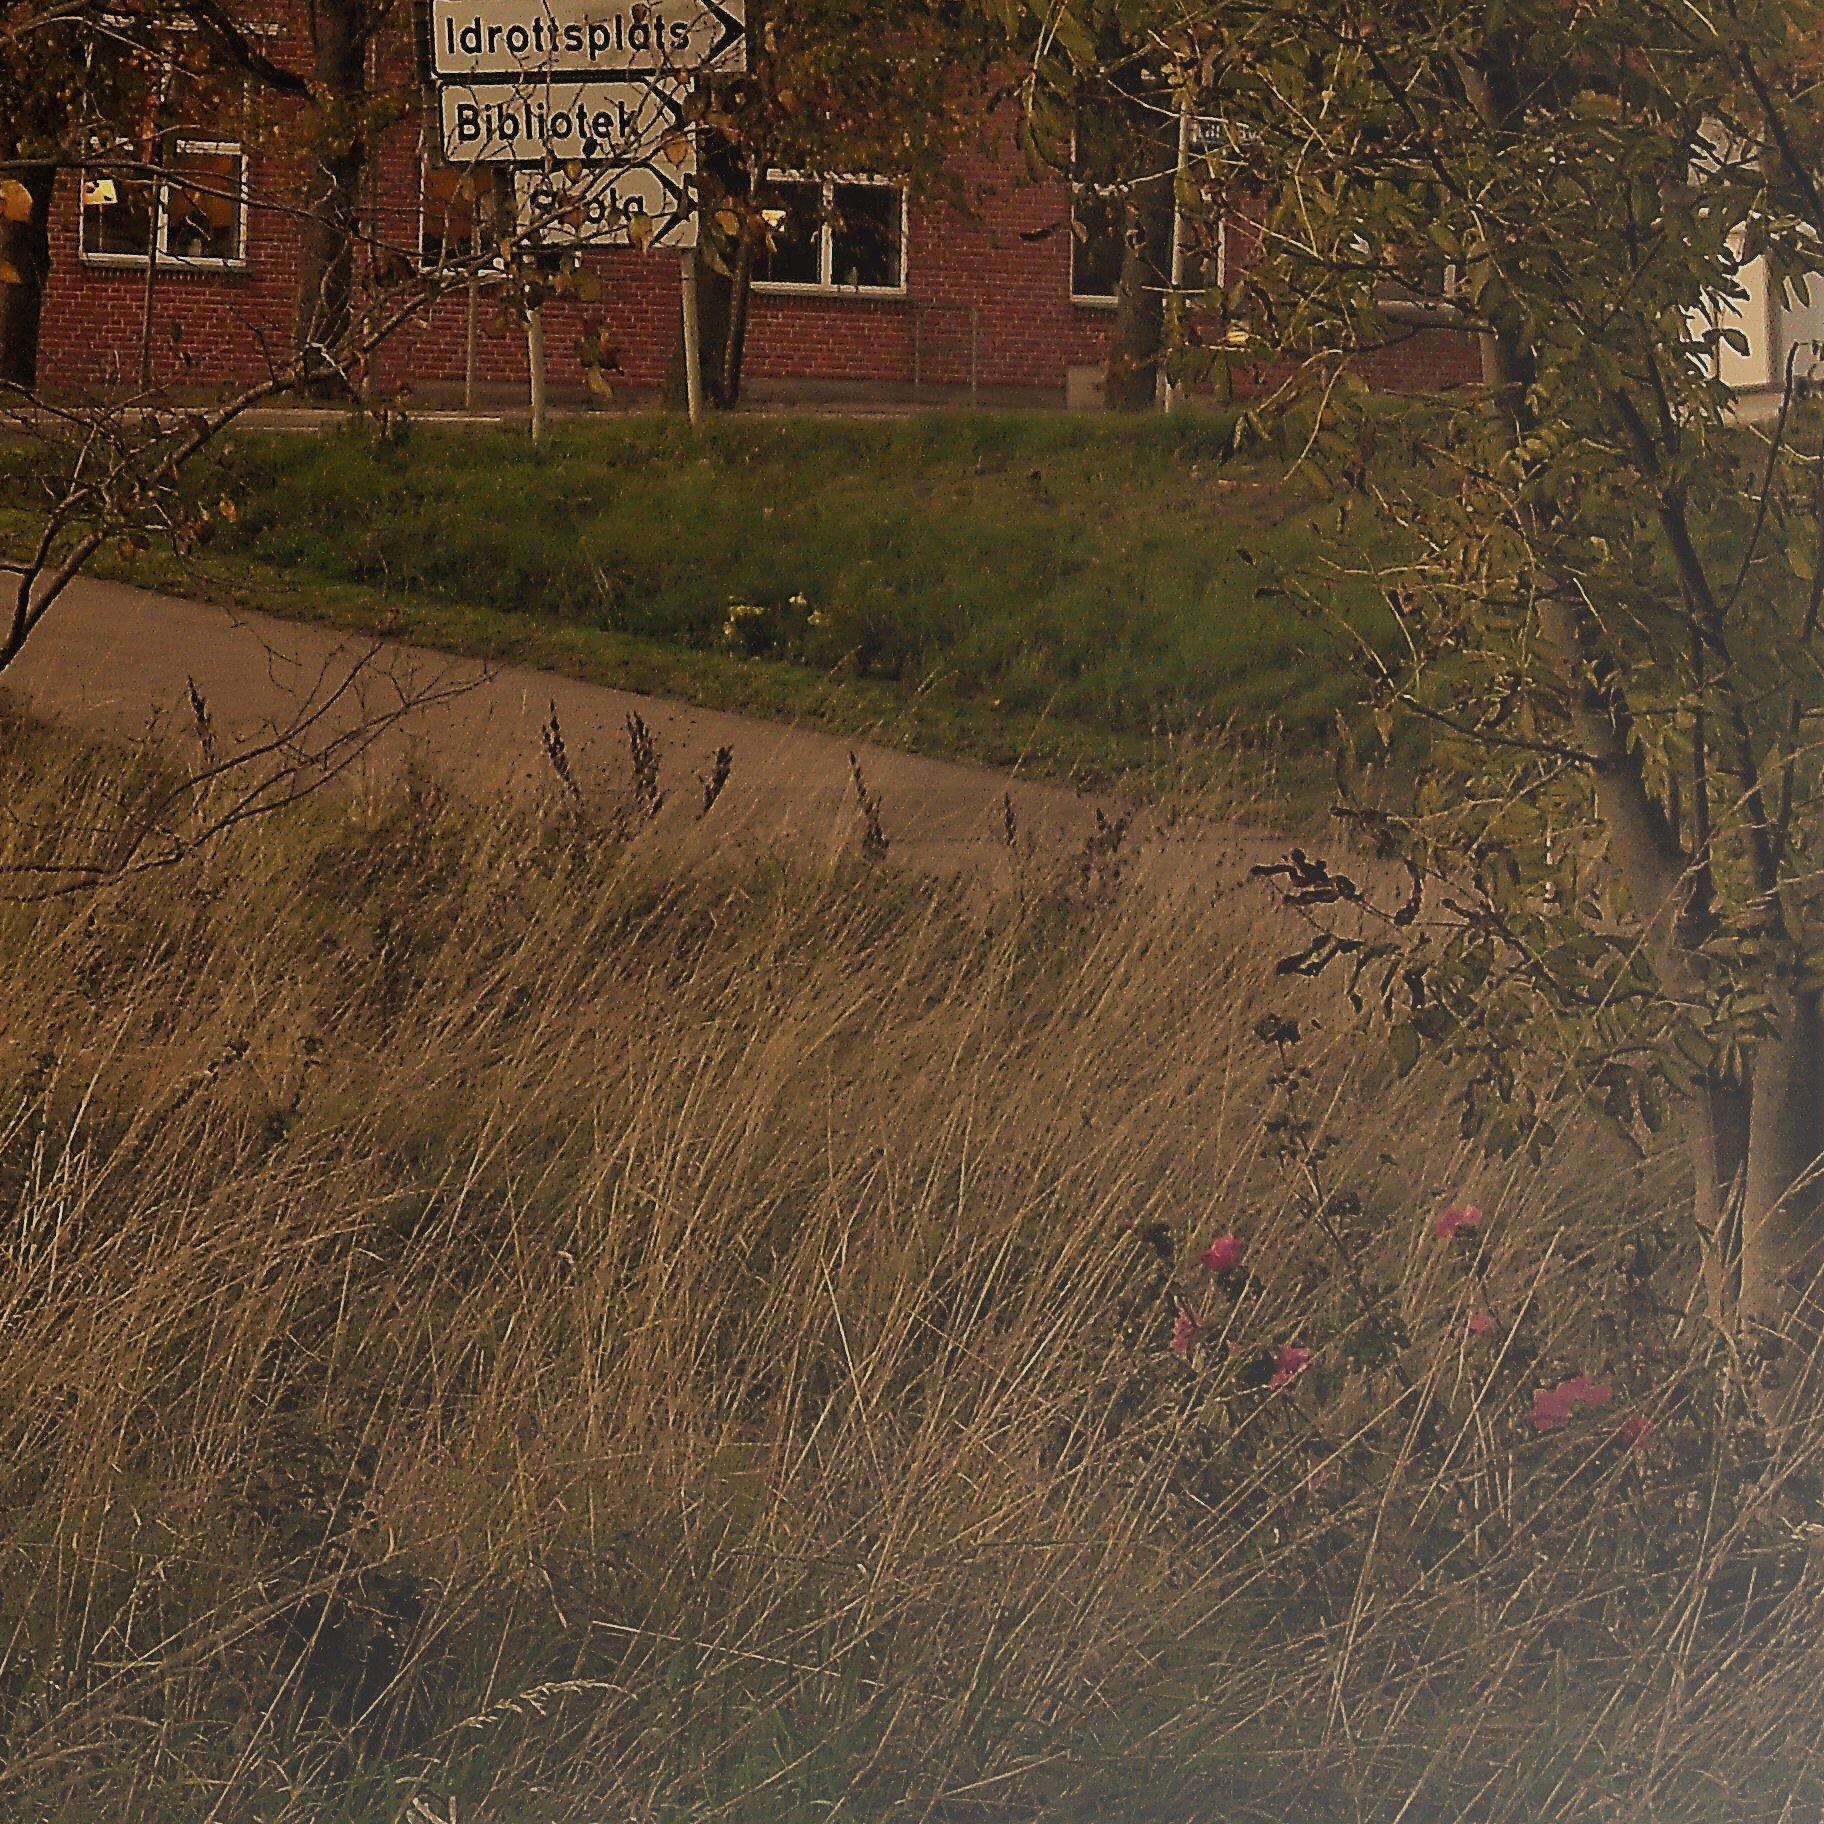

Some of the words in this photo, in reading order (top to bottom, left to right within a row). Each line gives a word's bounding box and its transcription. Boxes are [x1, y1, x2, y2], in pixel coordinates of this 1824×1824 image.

[446, 15, 690, 60] Idrottsplats
[456, 100, 640, 142] Bibliotek
[529, 187, 645, 225] Sola
